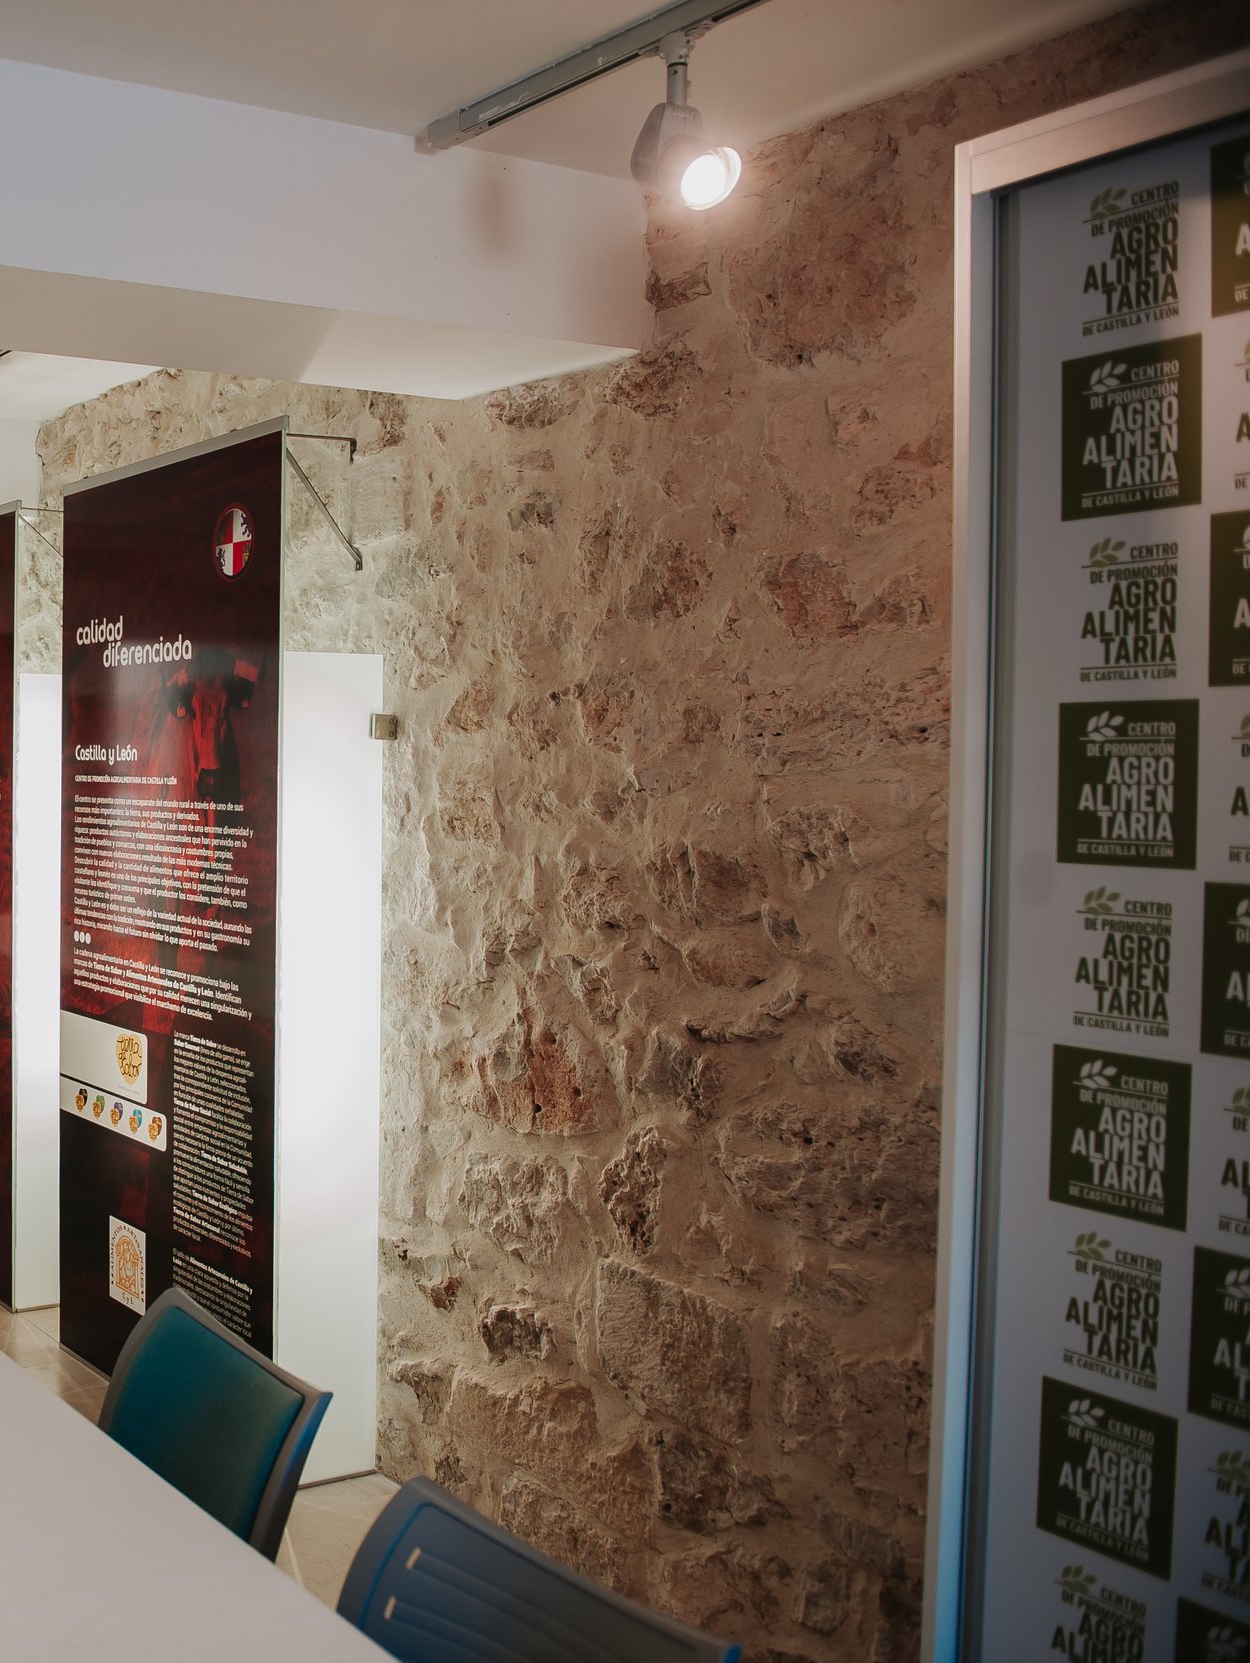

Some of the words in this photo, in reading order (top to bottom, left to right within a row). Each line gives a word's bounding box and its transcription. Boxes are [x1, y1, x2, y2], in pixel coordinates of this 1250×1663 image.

[1131, 180, 1179, 207] CENTRO
[1091, 221, 1106, 238] DE
[1108, 198, 1179, 233] PROMOCIÓN
[1110, 215, 1178, 260] AGRO
[1082, 243, 1178, 294] ALIMEN
[1102, 272, 1178, 315] TARIA
[1082, 324, 1094, 337] DE
[1096, 313, 1142, 334] CASTILLA
[1144, 311, 1152, 323] Y
[1153, 302, 1179, 321] LEÓN
[1131, 360, 1179, 382] CENTRO
[1091, 394, 1105, 410] DE
[1108, 378, 1179, 407] PROMOCIÓN
[1109, 395, 1178, 434] AGRO
[1082, 423, 1177, 466] ALIMEN
[1101, 452, 1178, 490] TARIA
[1081, 497, 1093, 509] DE
[1095, 491, 1141, 507] CASTILLA
[1143, 490, 1151, 501] Y
[1152, 484, 1179, 500] LEÓN
[1130, 541, 1178, 560] CENTRO
[1089, 569, 1104, 584] DE
[1106, 558, 1178, 583] PROMOCIÓN
[1108, 576, 1177, 610] AGRO
[76, 615, 123, 645] calidad
[1080, 605, 1176, 639] ALIMEN
[103, 634, 192, 667] diferenciada
[1099, 633, 1176, 665] TARIA
[1080, 671, 1092, 682] DE
[1093, 669, 1139, 681] CASTILLA
[1141, 669, 1150, 680] Y
[1150, 664, 1177, 679] LEÓN
[1127, 722, 1176, 736] CENTRO
[75, 745, 106, 761] Castilla
[108, 748, 114, 765] y
[116, 744, 137, 761] León
[1087, 743, 1102, 757] DE
[1104, 738, 1176, 757] PROMOCIÓN
[1105, 756, 1175, 786] AGRO
[1077, 783, 1174, 814] ALIMEN
[1097, 810, 1173, 842] TARIA
[1077, 843, 1089, 853] DE
[1090, 843, 1136, 856] CASTILLA
[1138, 846, 1146, 857] Y
[1147, 843, 1174, 858] LEÓN
[1124, 899, 1172, 916] CENTRO
[1084, 917, 1099, 931] DE
[1101, 917, 1172, 937] PROMOCIÓN
[1102, 931, 1171, 965] AGRO
[1074, 956, 1170, 992] ALIMEN
[1093, 984, 1169, 1020] TARIA
[1073, 1015, 1085, 1027] DE
[1086, 1017, 1133, 1032] CASTILLA
[1134, 1022, 1143, 1033] Y
[1143, 1021, 1170, 1036] LEÓN
[1120, 1075, 1169, 1096] CENTRO
[1080, 1089, 1095, 1104] DE
[1097, 1092, 1168, 1117] PROMOCIÓN
[1098, 1105, 1167, 1144] AGRO
[1070, 1127, 1165, 1171] ALIMEN
[1089, 1156, 1163, 1198] TARIA
[1069, 1184, 1081, 1197] DE
[1082, 1187, 1128, 1206] CASTILLA
[1129, 1197, 1138, 1208] Y
[1138, 1198, 1164, 1214] LEÓN
[1075, 1258, 1089, 1275] DE
[1091, 1262, 1161, 1293] PROMOCIÓN
[1114, 1248, 1162, 1273] CENTRO
[1092, 1277, 1160, 1321] AGRO
[1065, 1296, 1158, 1348] ALIMEN
[1063, 1352, 1075, 1365] DE
[1076, 1356, 1121, 1380] CASTILLA
[1083, 1326, 1157, 1375] TARIA
[1068, 1424, 1083, 1442] DE
[1108, 1418, 1155, 1446] CENTRO
[1085, 1444, 1152, 1493] AGRO
[1058, 1461, 1151, 1519] ALIMEN
[1076, 1492, 1149, 1546] TARIA
[1078, 1604, 1144, 1662] AGRO
